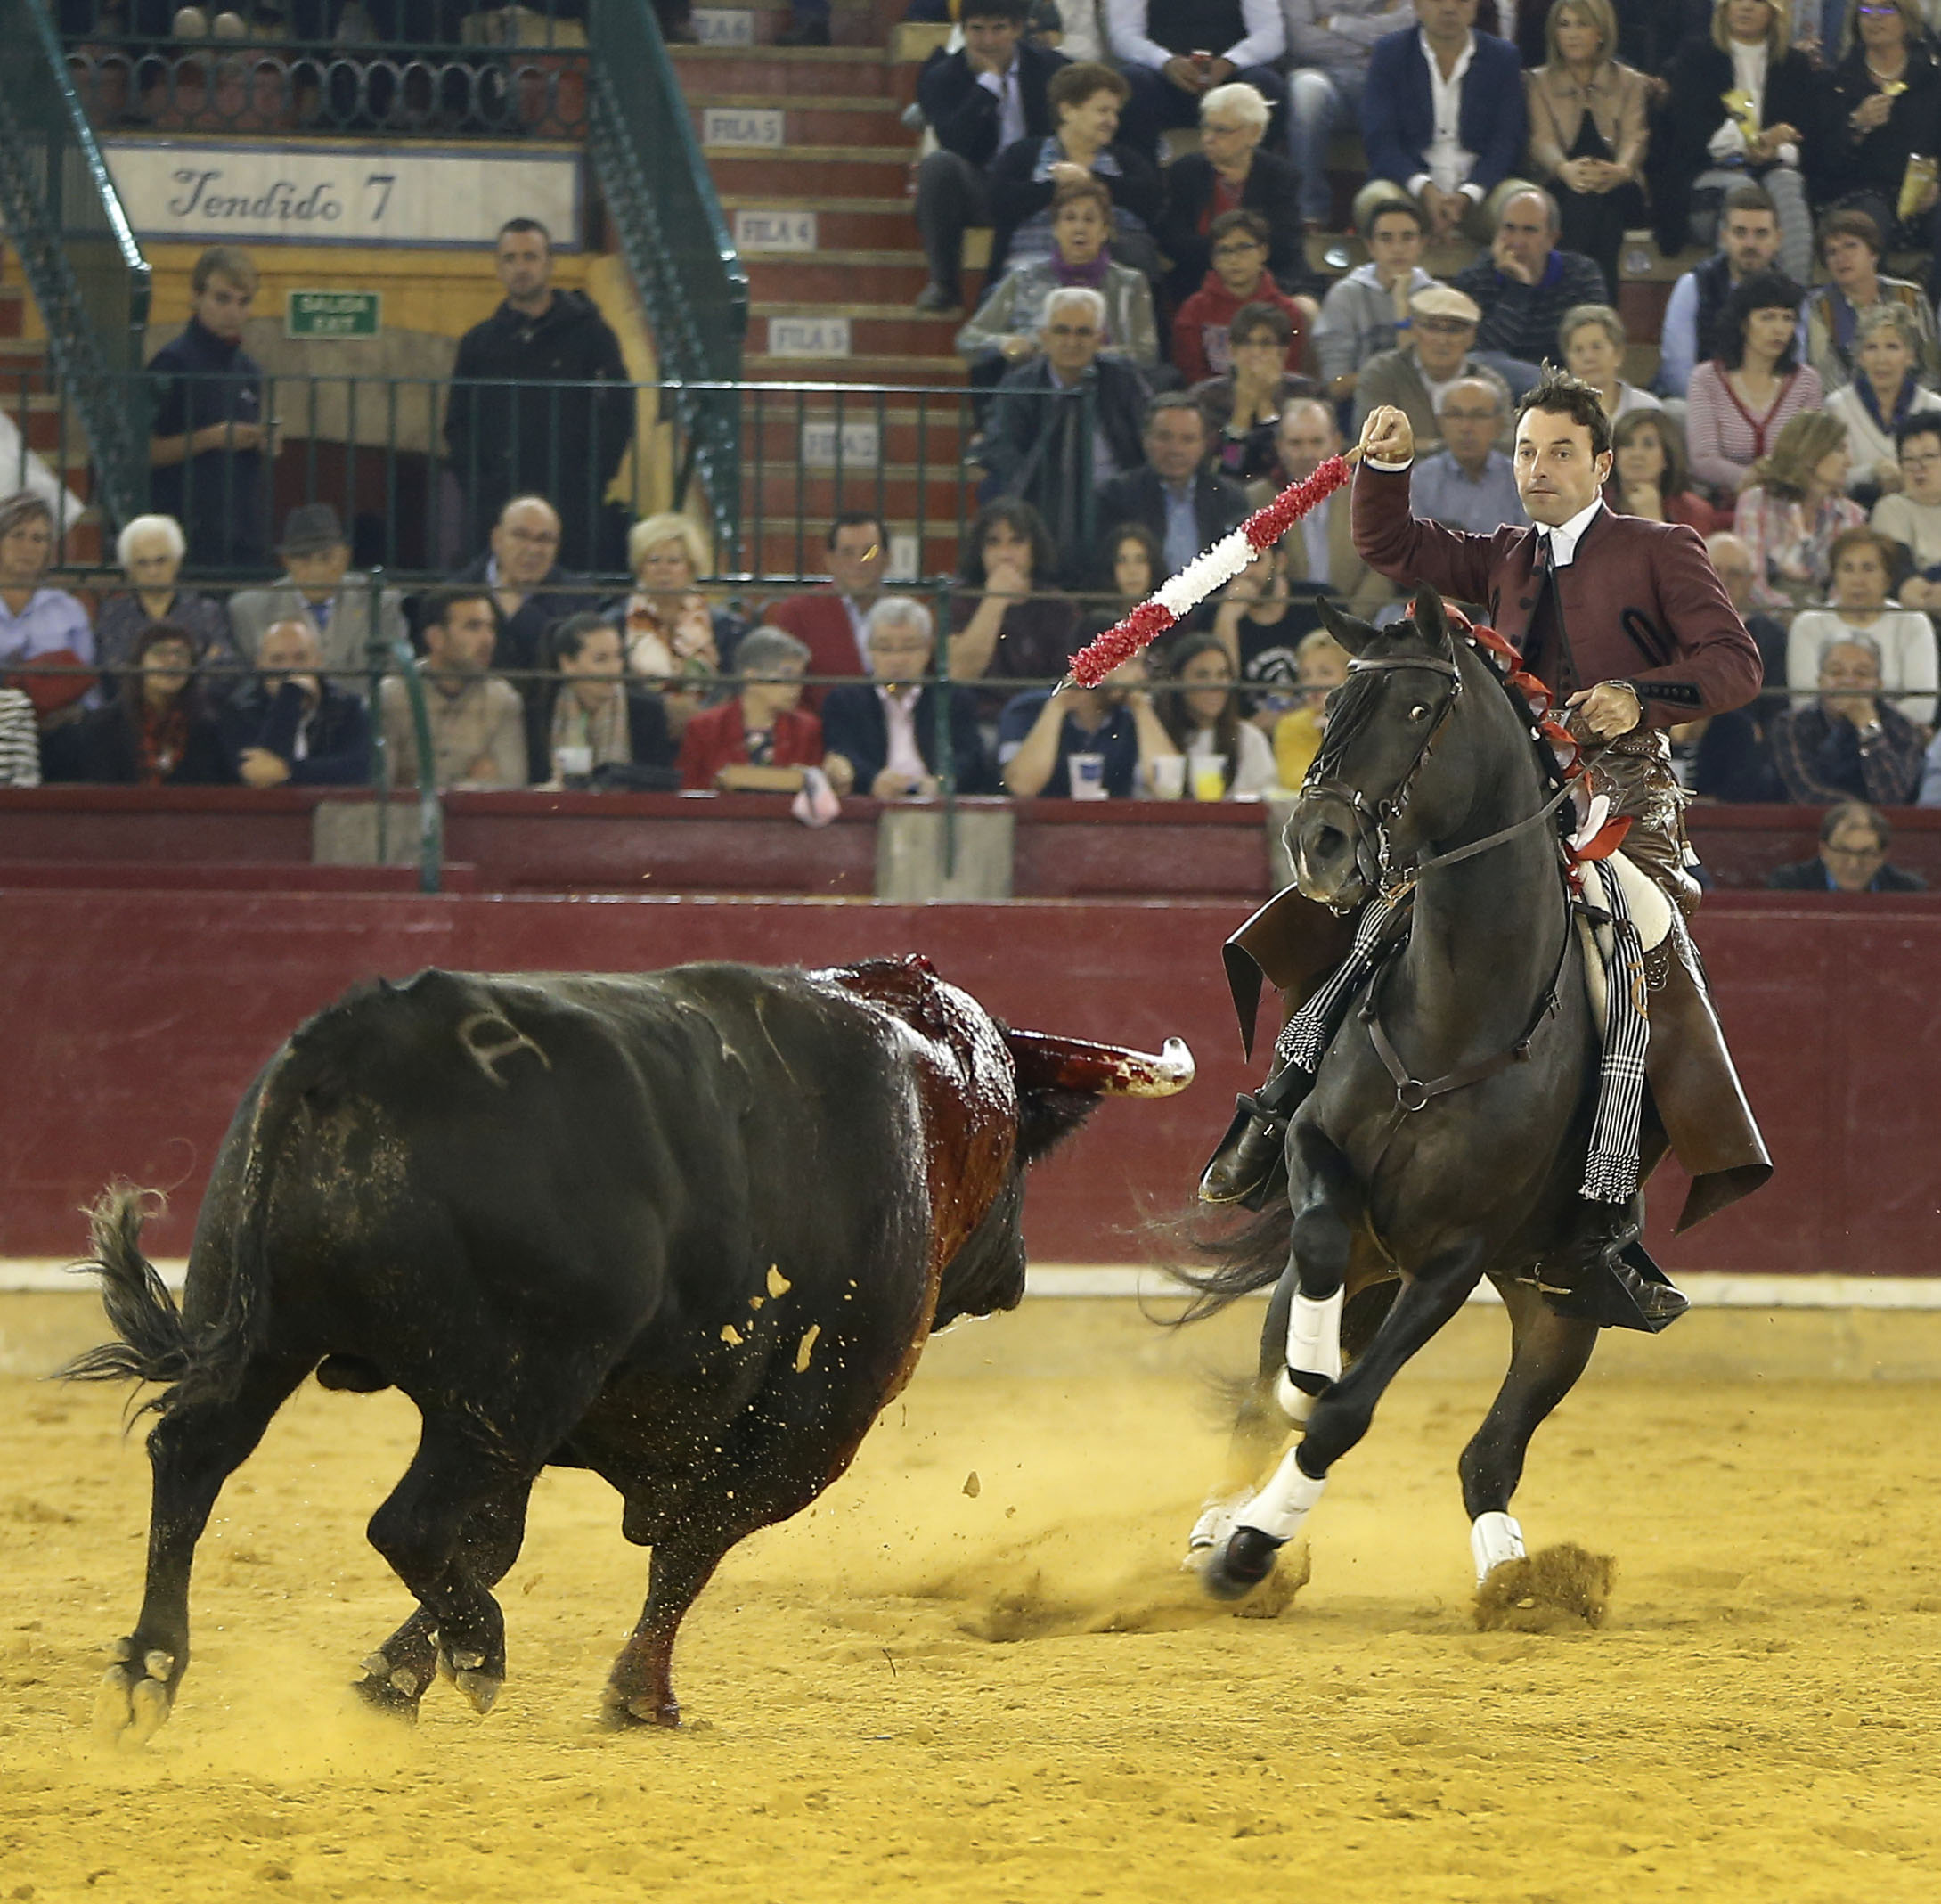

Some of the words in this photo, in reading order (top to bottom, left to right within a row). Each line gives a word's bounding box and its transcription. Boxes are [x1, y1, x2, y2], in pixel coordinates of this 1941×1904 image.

[712, 118, 759, 141] FILA
[168, 169, 343, 221] Tendido
[363, 172, 396, 221] 7
[743, 219, 790, 242] FILA
[777, 327, 825, 349] FILA
